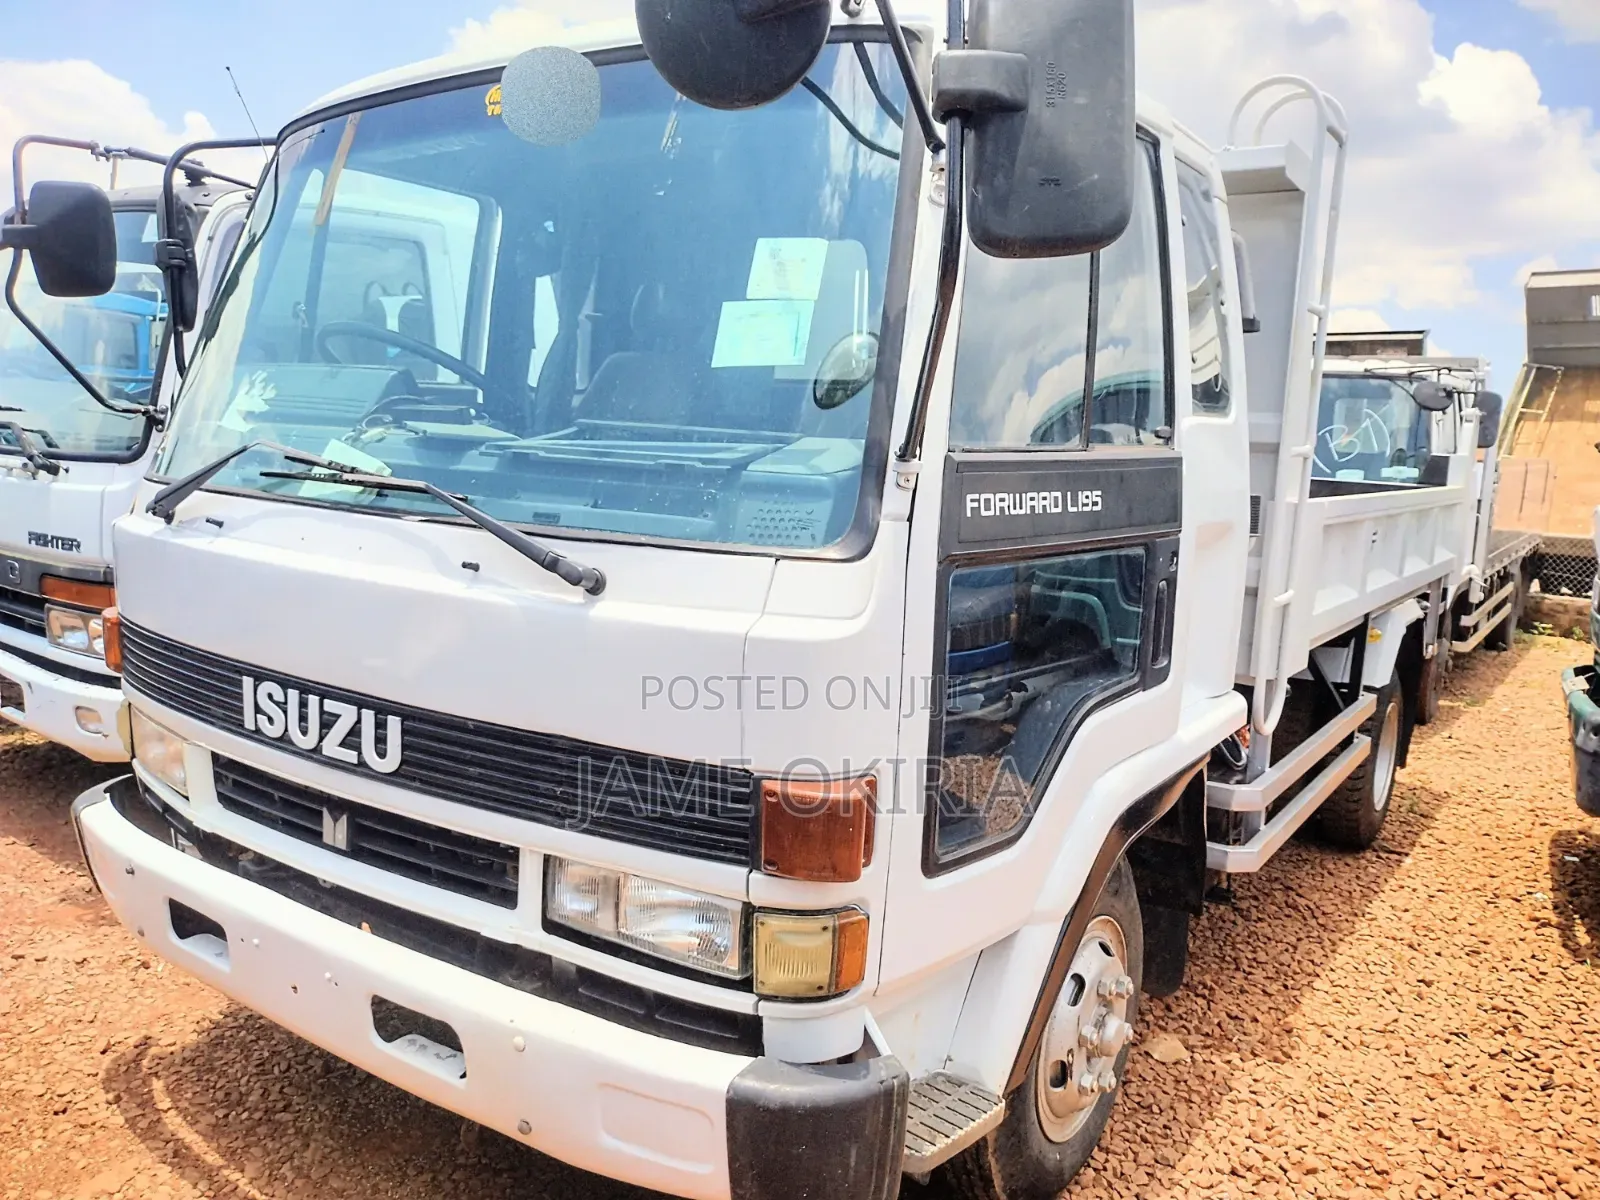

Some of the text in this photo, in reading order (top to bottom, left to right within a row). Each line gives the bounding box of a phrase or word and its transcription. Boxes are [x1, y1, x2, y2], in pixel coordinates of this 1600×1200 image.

[966, 491, 1063, 518] FORWARD
[27, 530, 82, 554] FIGHTER
[242, 675, 402, 774] ISUZU
